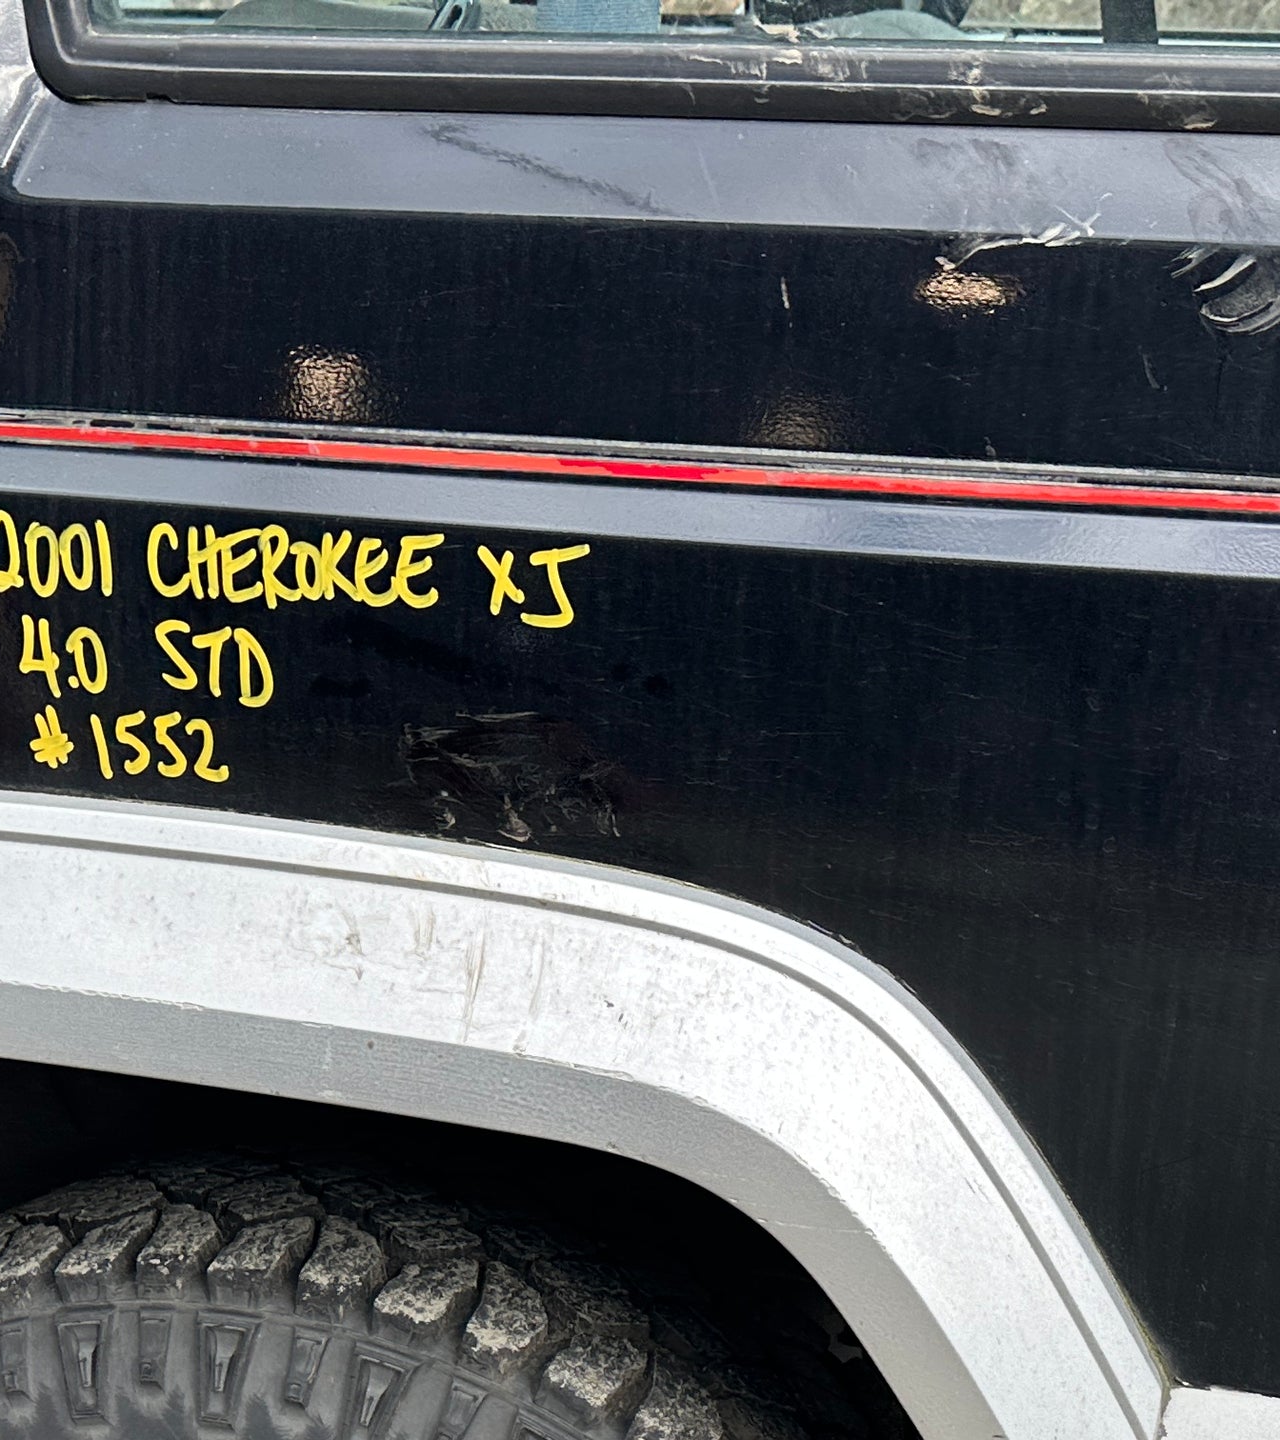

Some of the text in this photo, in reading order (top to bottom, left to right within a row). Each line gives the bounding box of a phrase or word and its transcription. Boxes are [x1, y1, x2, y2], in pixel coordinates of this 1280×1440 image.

[145, 522, 444, 609] CHEROKEE
[477, 544, 589, 629] XJ
[18, 614, 275, 708] 4.0 STD
[29, 705, 230, 783] #1552
